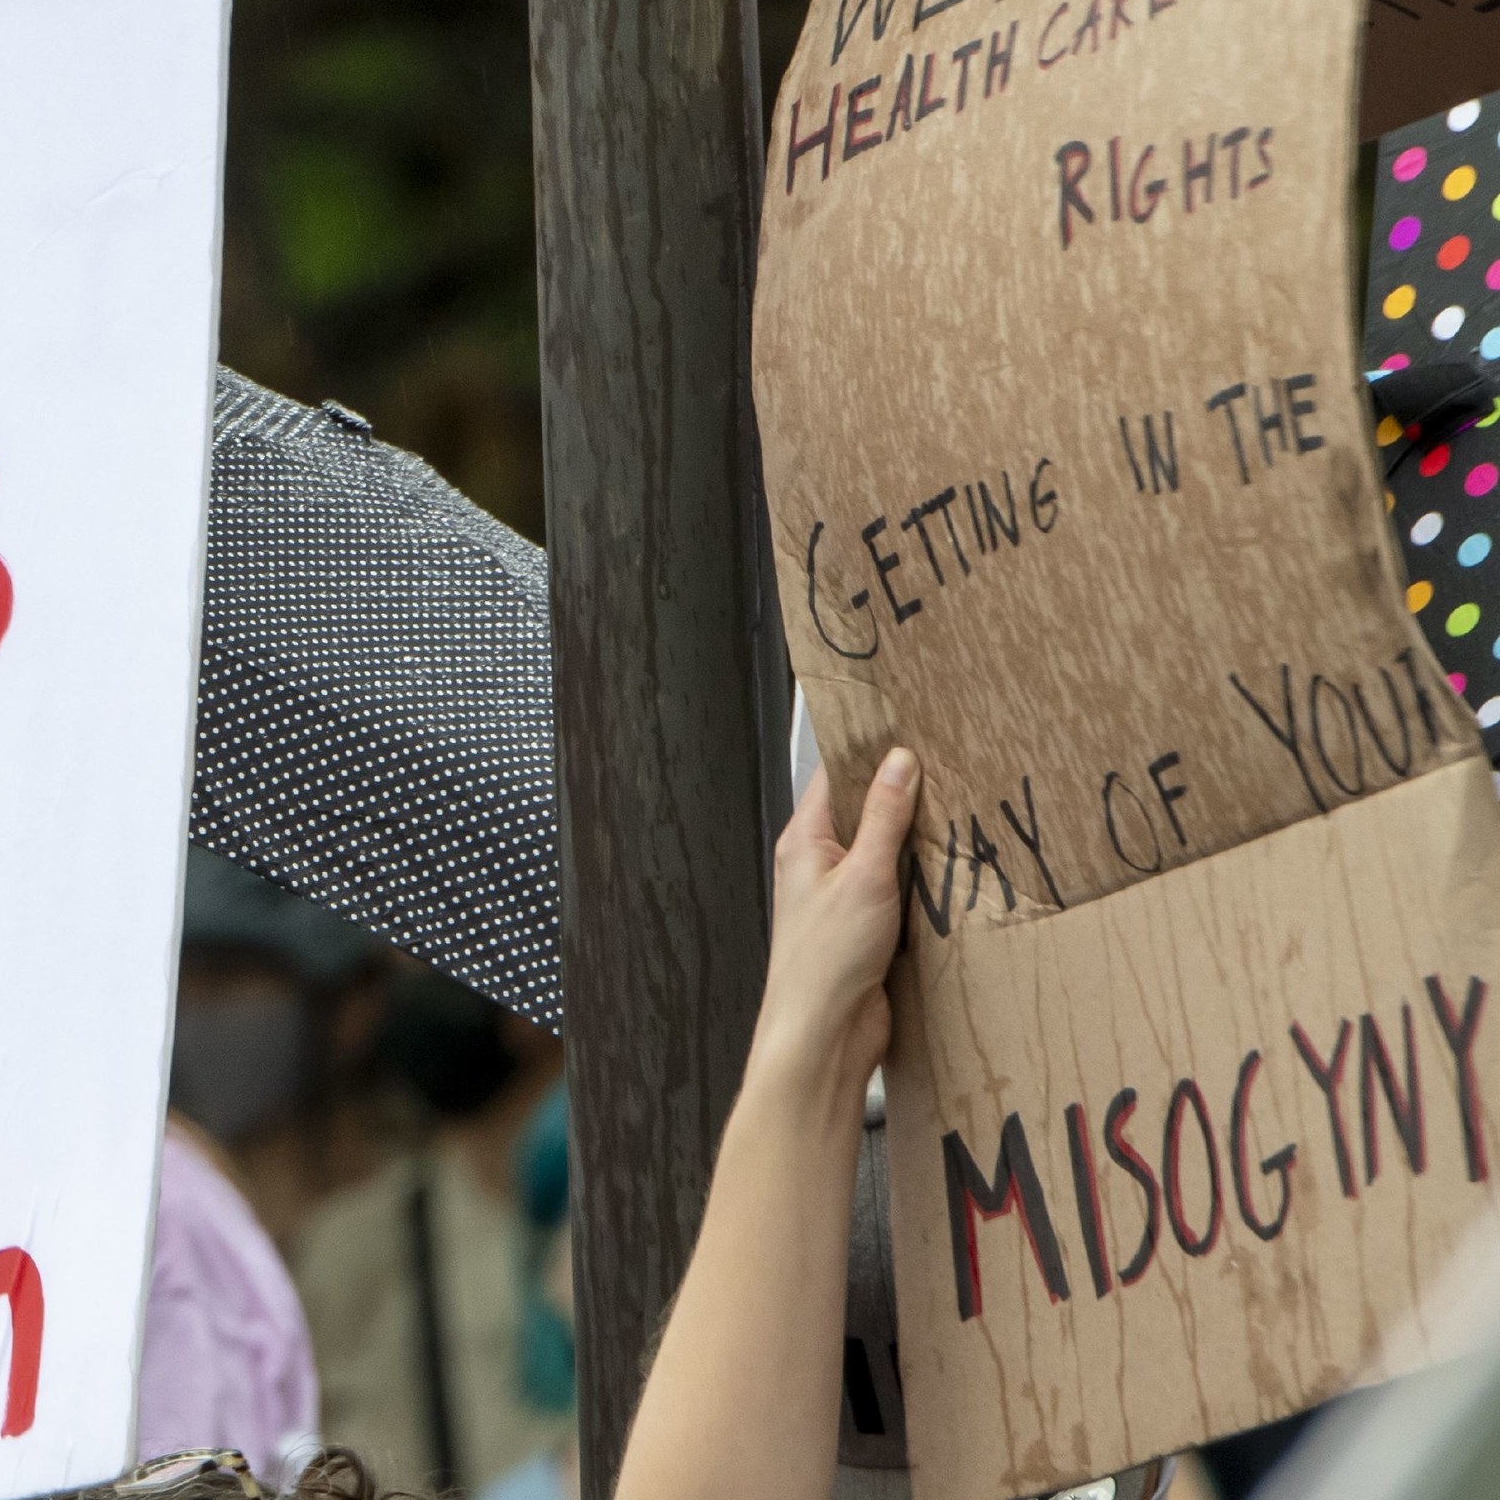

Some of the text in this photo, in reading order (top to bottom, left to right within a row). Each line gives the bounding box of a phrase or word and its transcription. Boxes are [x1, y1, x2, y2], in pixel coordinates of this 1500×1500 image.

[785, 21, 1014, 195] HEALTH
[1056, 126, 1275, 250] RIGHTS
[806, 373, 1325, 660] GETTING IN THE
[1101, 750, 1187, 874] OF
[942, 972, 1489, 1322] MISOGYNY
